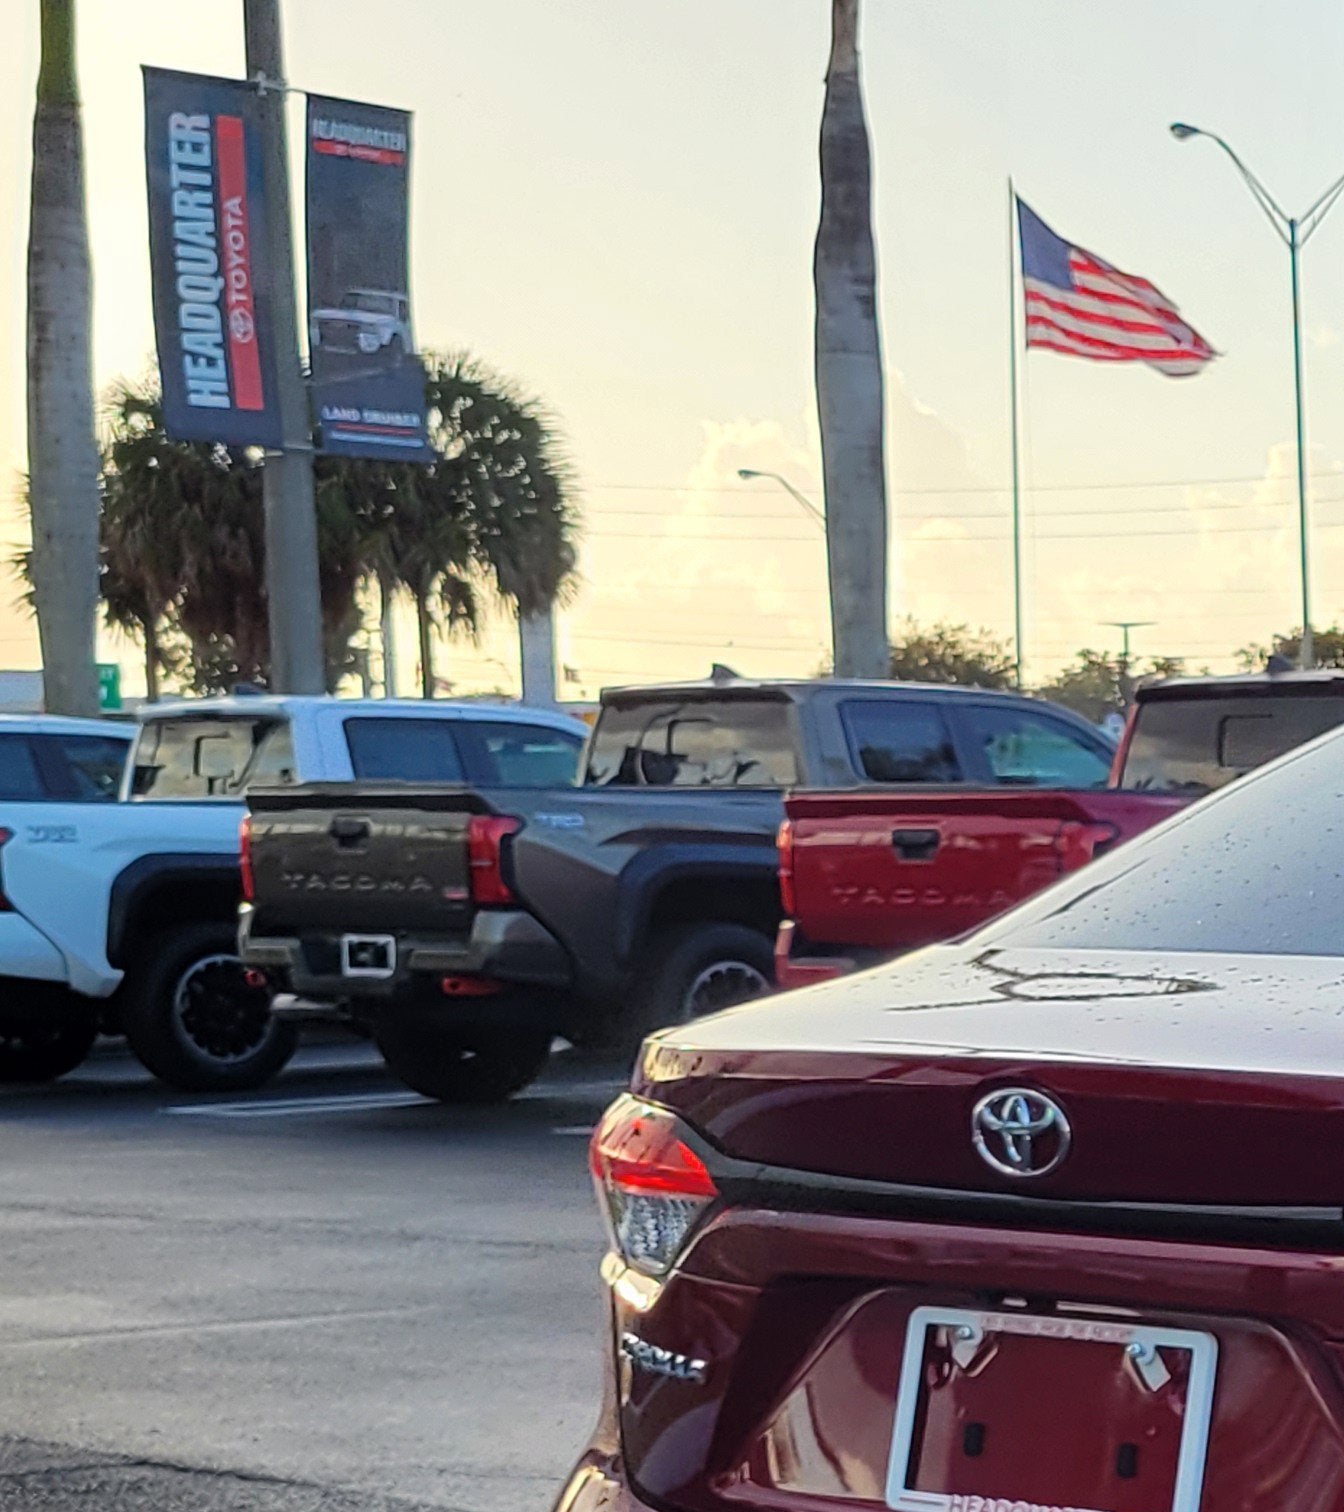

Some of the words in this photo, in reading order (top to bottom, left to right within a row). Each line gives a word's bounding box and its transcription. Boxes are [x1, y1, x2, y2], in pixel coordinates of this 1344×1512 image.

[168, 111, 231, 410] HEADQUARTER
[222, 195, 249, 302] TOYOTA
[321, 405, 360, 422] LAND
[281, 872, 432, 891] TACOMA
